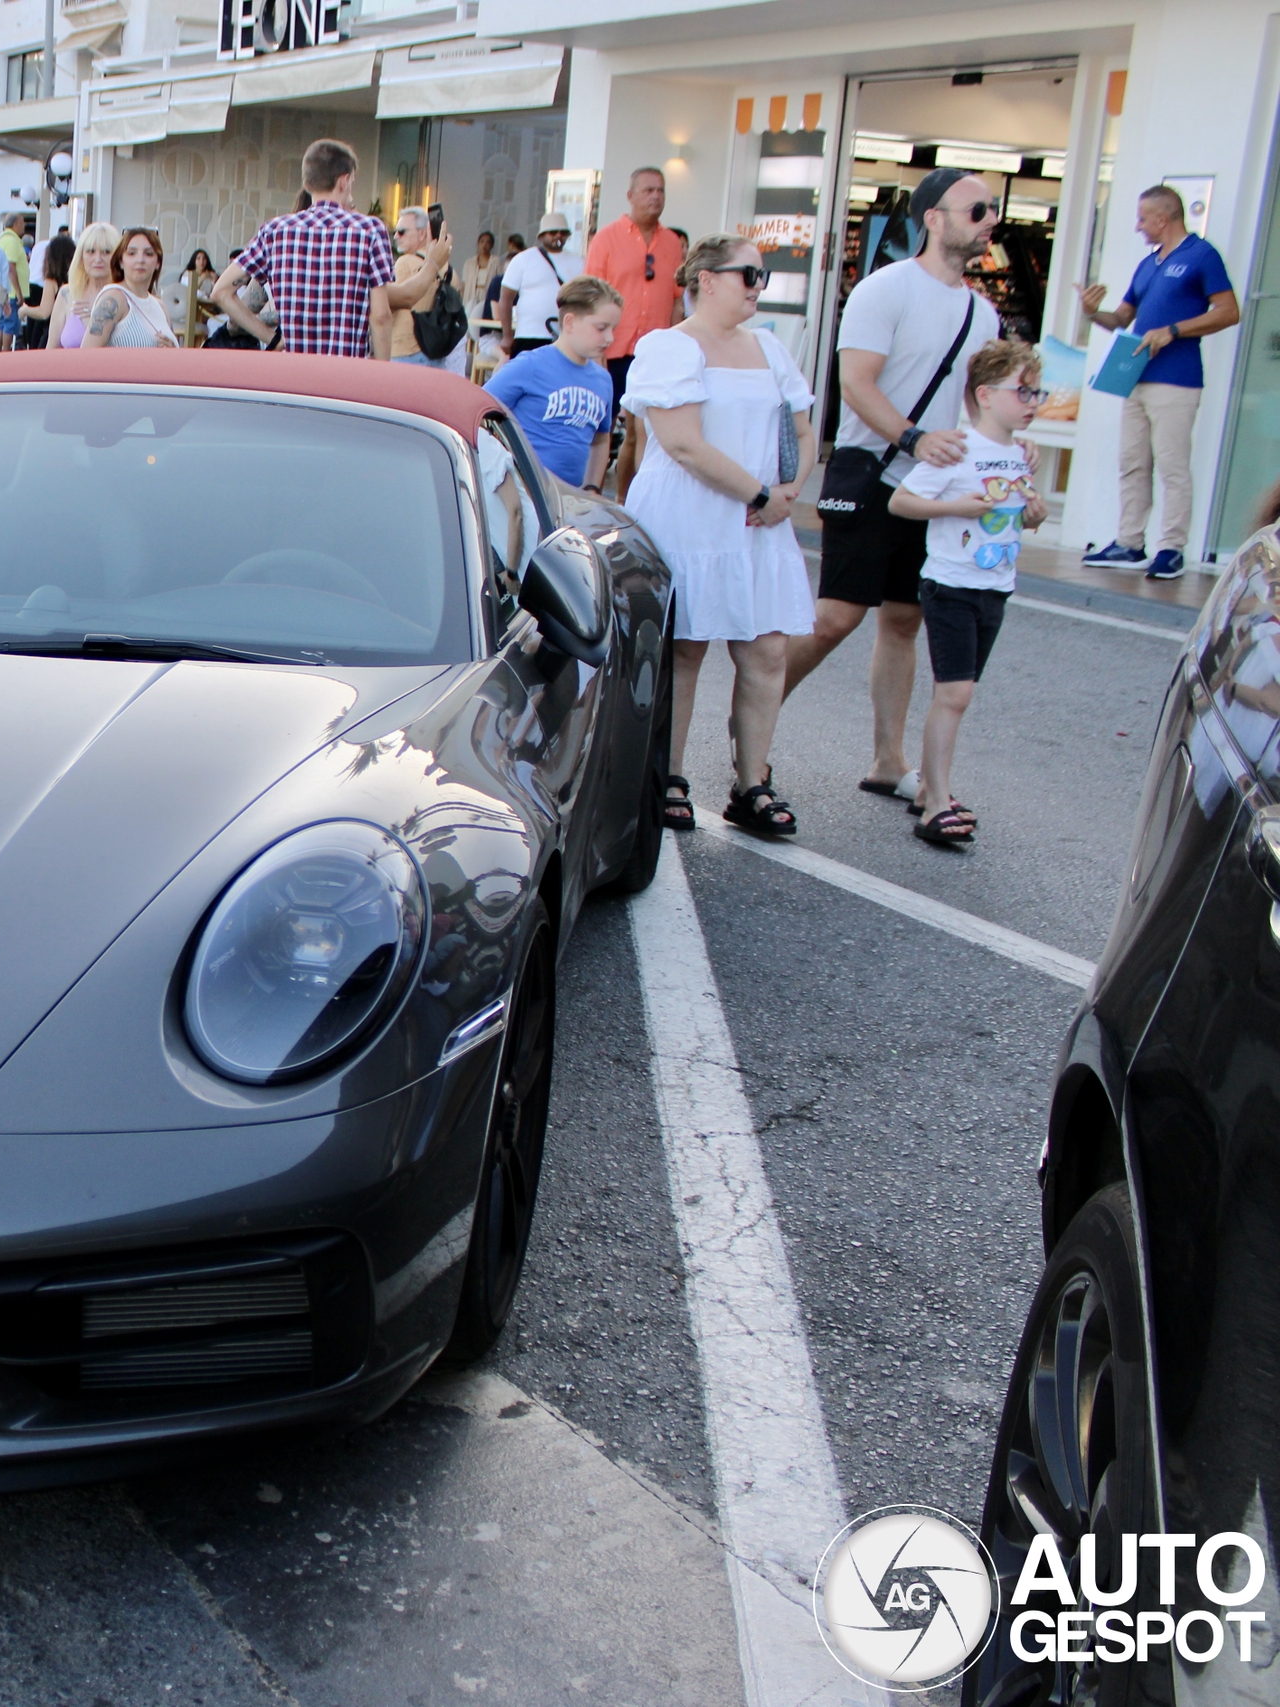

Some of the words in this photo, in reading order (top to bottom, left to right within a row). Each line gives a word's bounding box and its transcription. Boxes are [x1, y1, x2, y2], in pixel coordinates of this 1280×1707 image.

[216, 0, 340, 61] LEONE
[736, 219, 790, 240] SUMMER
[542, 386, 607, 430] BEVERLY
[975, 460, 1009, 472] SUMMER
[817, 498, 856, 511] adidas
